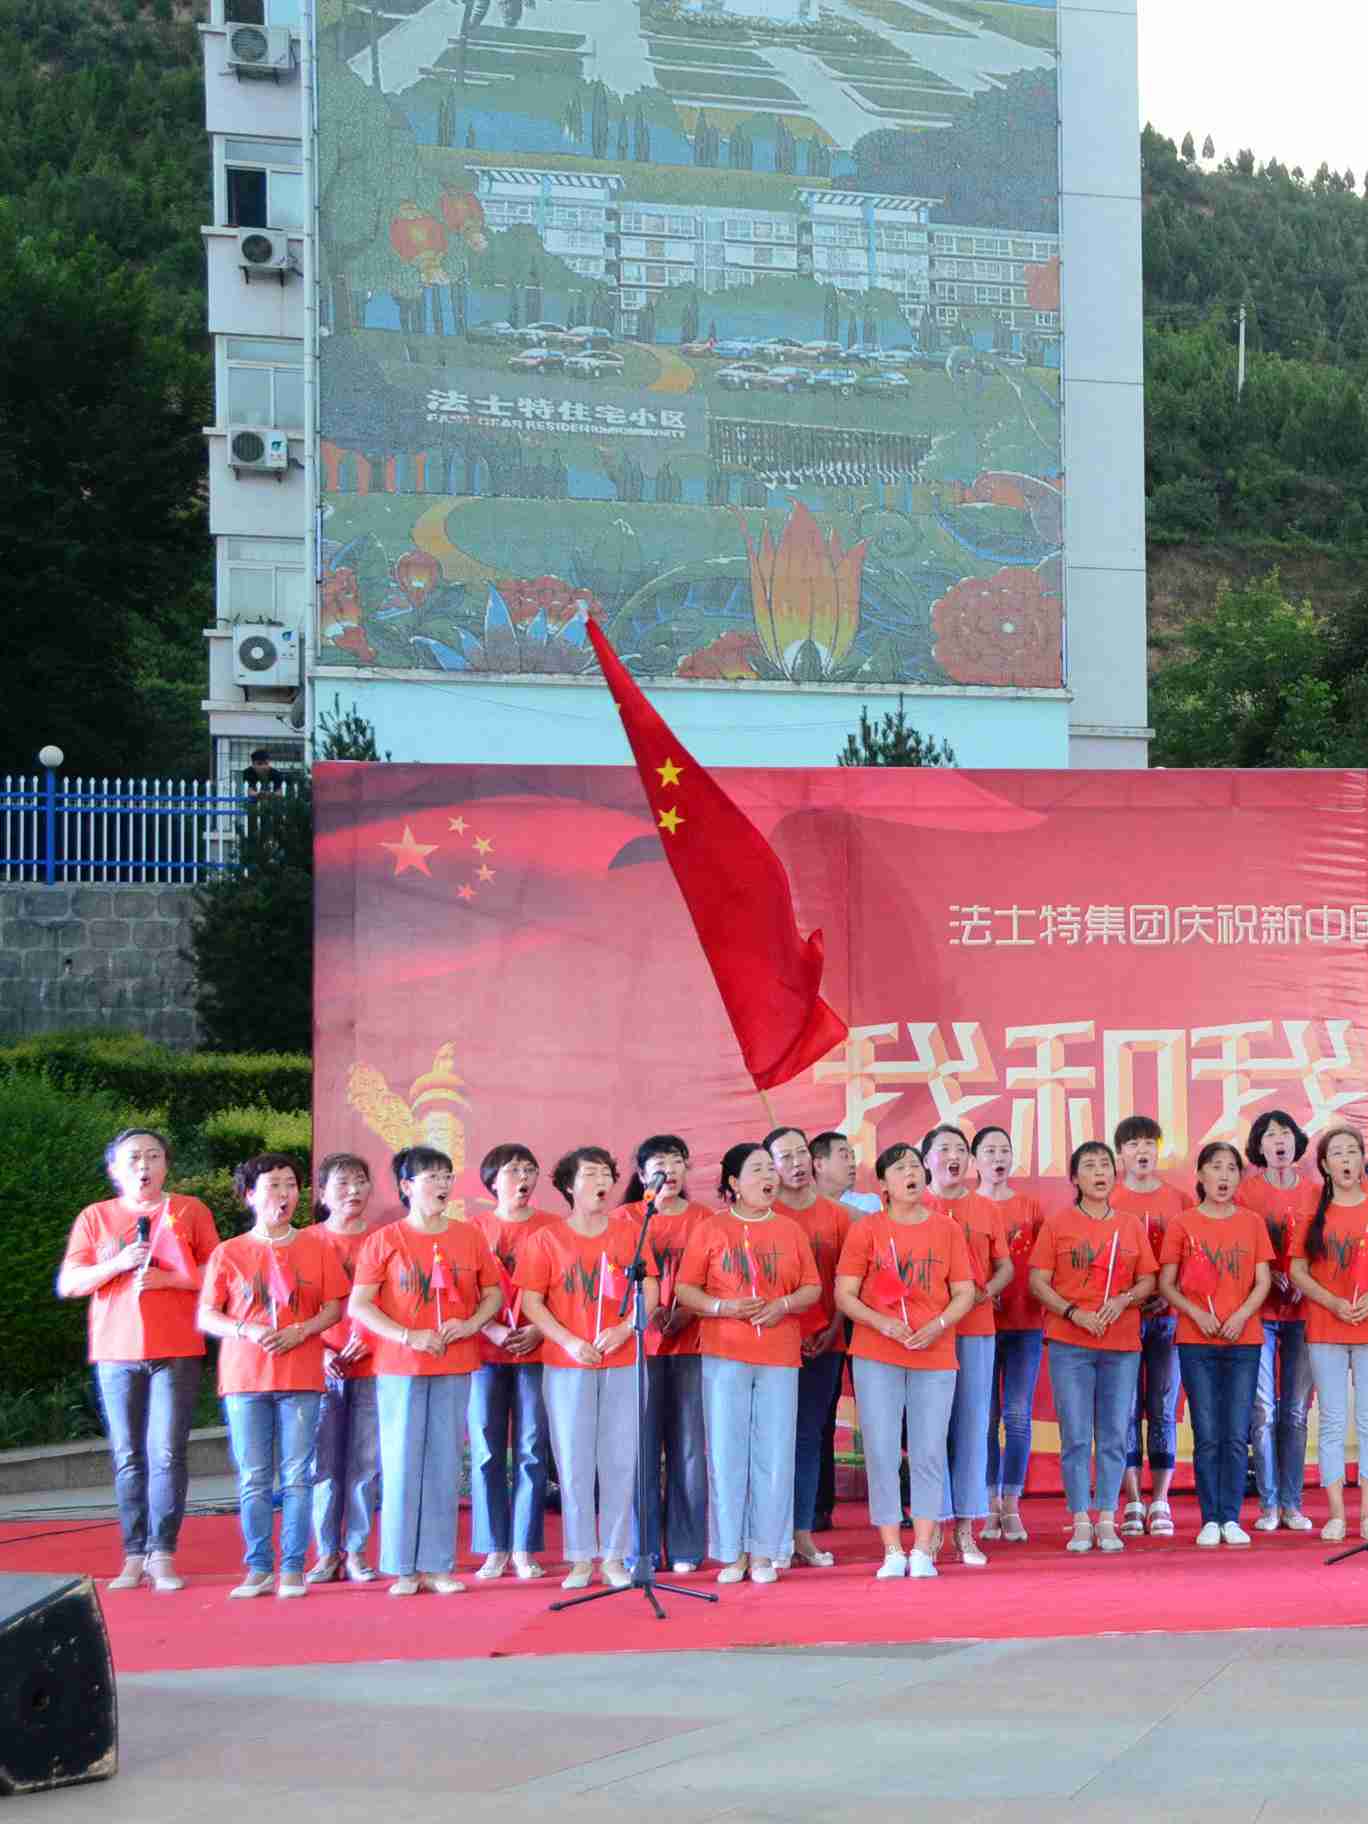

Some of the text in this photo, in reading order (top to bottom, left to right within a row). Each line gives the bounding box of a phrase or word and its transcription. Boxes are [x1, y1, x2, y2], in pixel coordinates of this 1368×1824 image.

[426, 389, 686, 429] 法士特住宅小区
